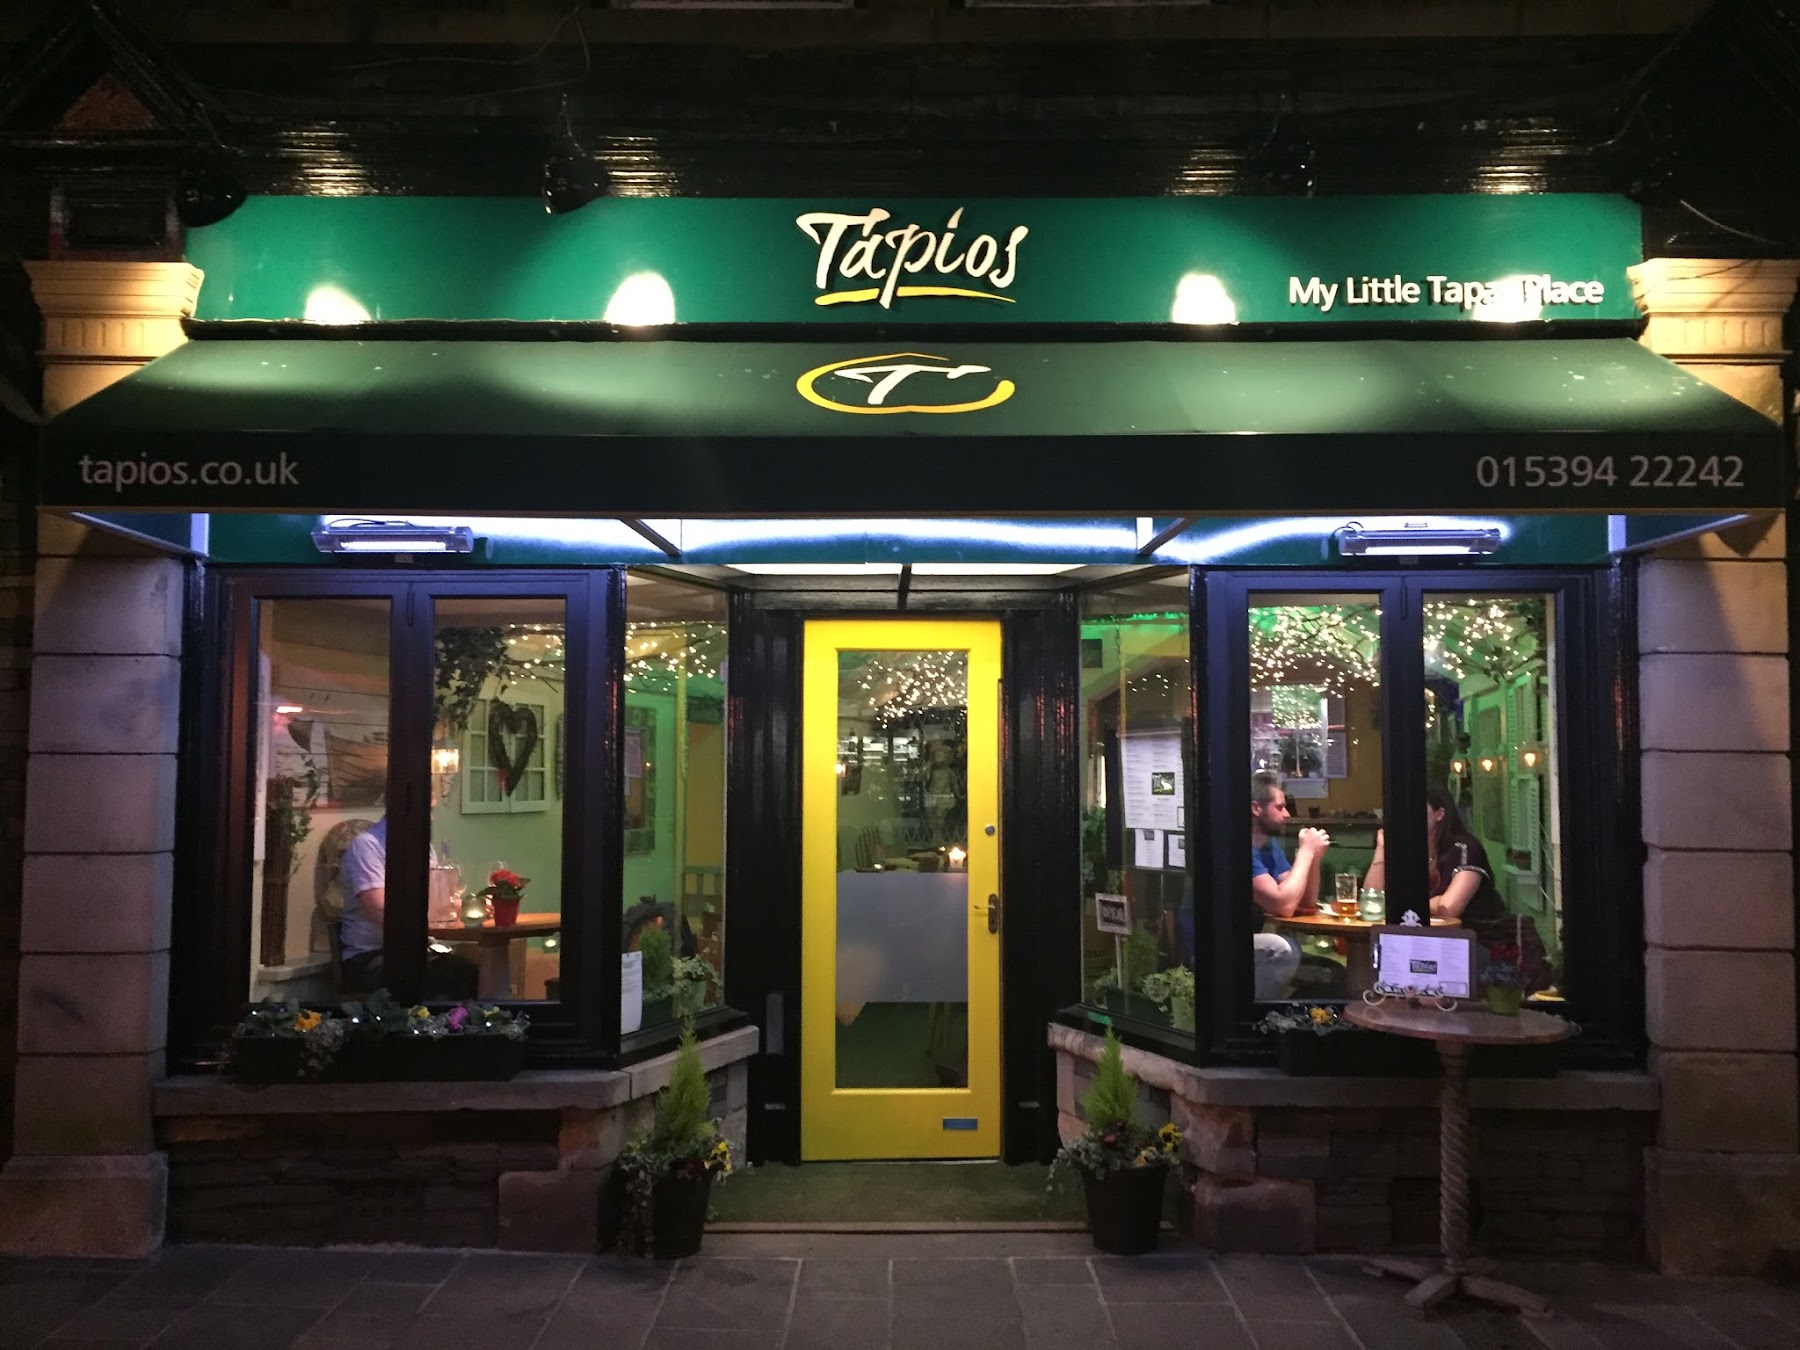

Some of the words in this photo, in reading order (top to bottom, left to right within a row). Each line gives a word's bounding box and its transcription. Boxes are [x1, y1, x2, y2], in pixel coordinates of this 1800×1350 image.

[796, 206, 1029, 310] Tapios
[1288, 276, 1338, 312] My
[1346, 275, 1421, 304] Little
[1426, 275, 1513, 310] Tapa
[1524, 273, 1605, 304] Place
[78, 451, 299, 493] tapios.co.uk
[1476, 455, 1618, 487] 015394
[1629, 455, 1744, 487] 22242
